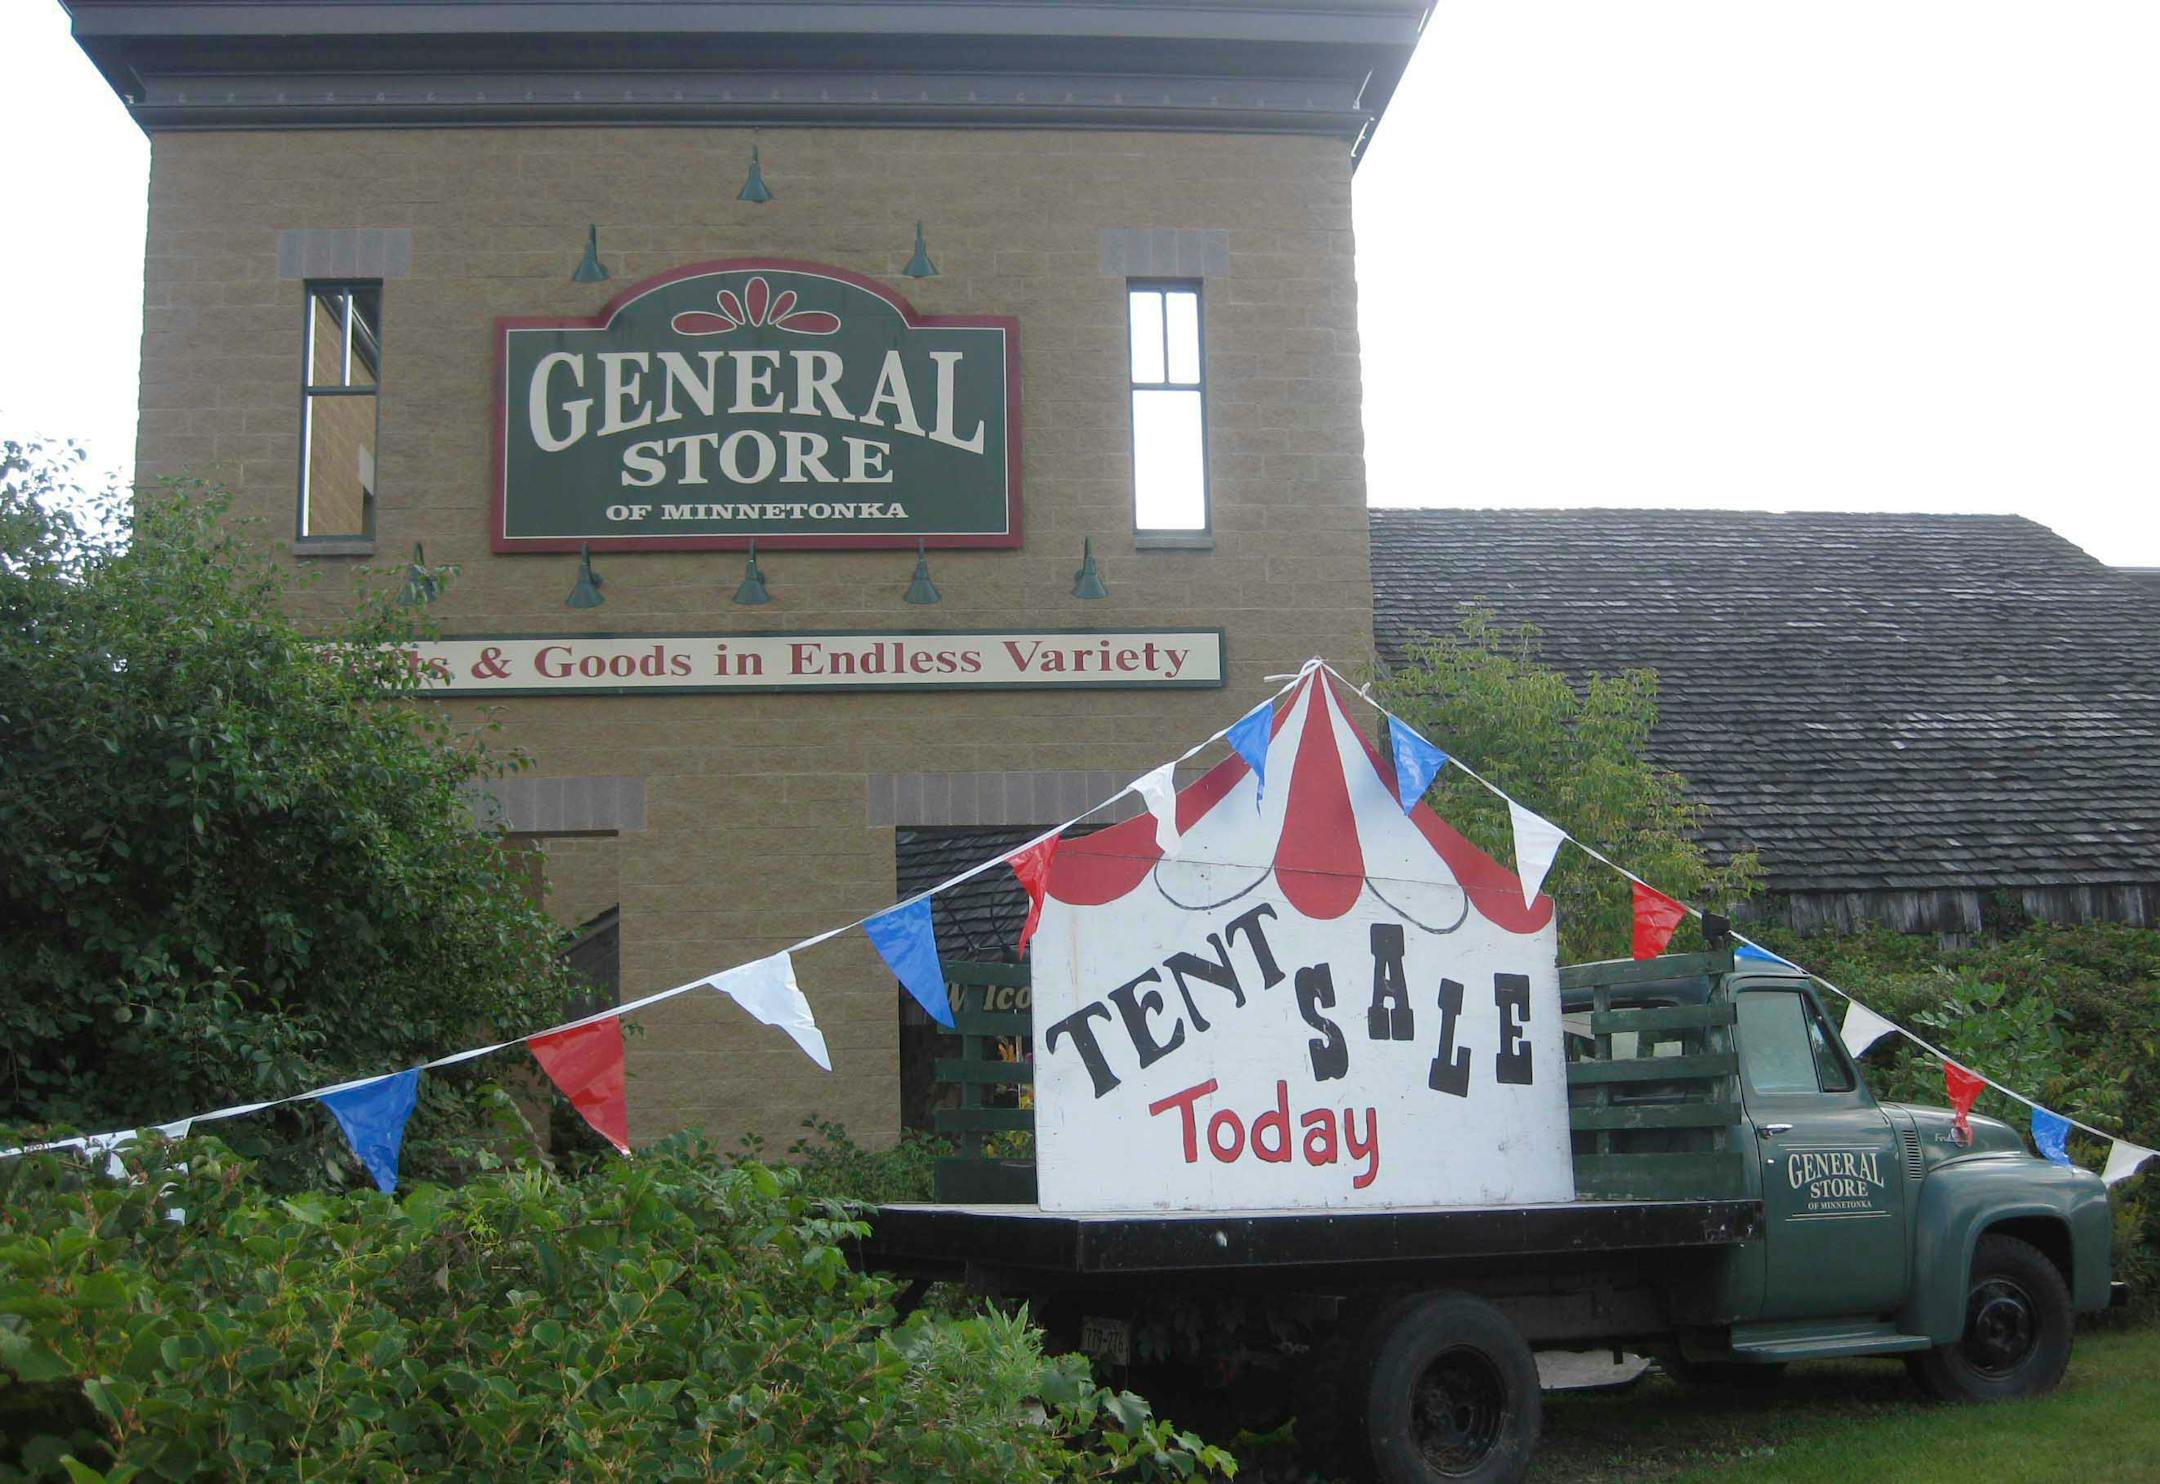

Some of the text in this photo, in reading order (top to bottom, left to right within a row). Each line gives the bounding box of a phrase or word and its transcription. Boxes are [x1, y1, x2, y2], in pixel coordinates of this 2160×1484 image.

[529, 350, 985, 455] GENERAL
[621, 429, 893, 486] STORE
[606, 502, 909, 521] OF MINNETONKA
[471, 647, 513, 679] &
[534, 645, 692, 678] Goods
[715, 644, 764, 676] in
[786, 642, 982, 675] Endless
[1001, 640, 1191, 678] Variety
[1045, 902, 1534, 1099] TENT SALE
[1148, 1078, 1379, 1189] Today
[1788, 1152, 1884, 1189] GENERAL
[1810, 1178, 1868, 1198] STORE
[1808, 1200, 1872, 1210] OF MINNETONKA
